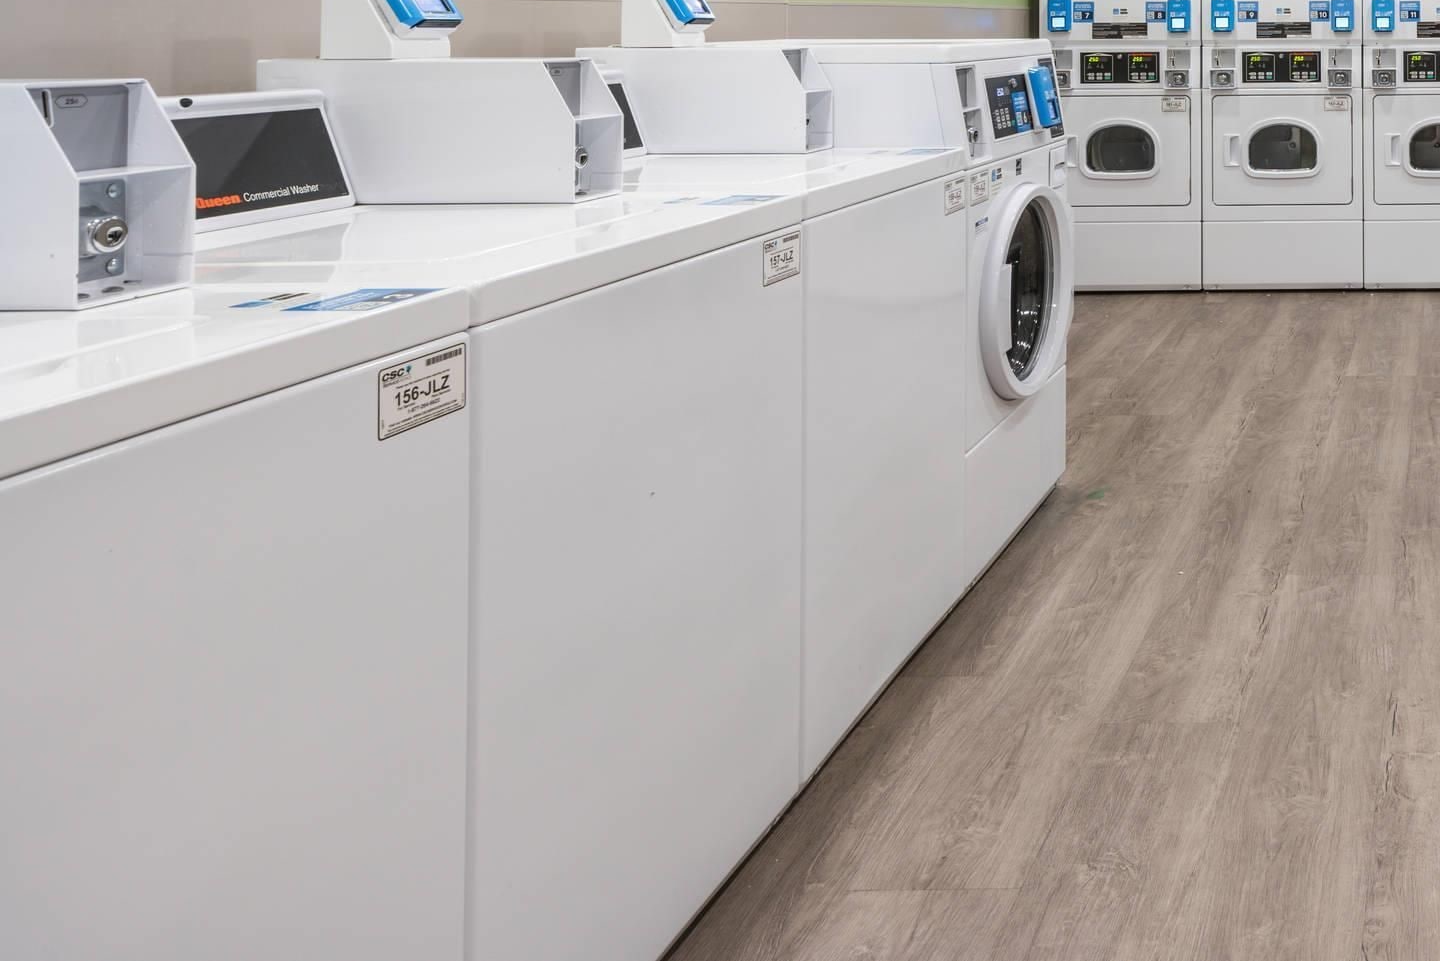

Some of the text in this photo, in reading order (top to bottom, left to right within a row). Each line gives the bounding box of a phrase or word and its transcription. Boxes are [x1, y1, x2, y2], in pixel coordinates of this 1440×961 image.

[196, 183, 320, 209] Queen Commercial Washer
[382, 368, 405, 382] CSC
[394, 374, 450, 407] 156-JLZ
